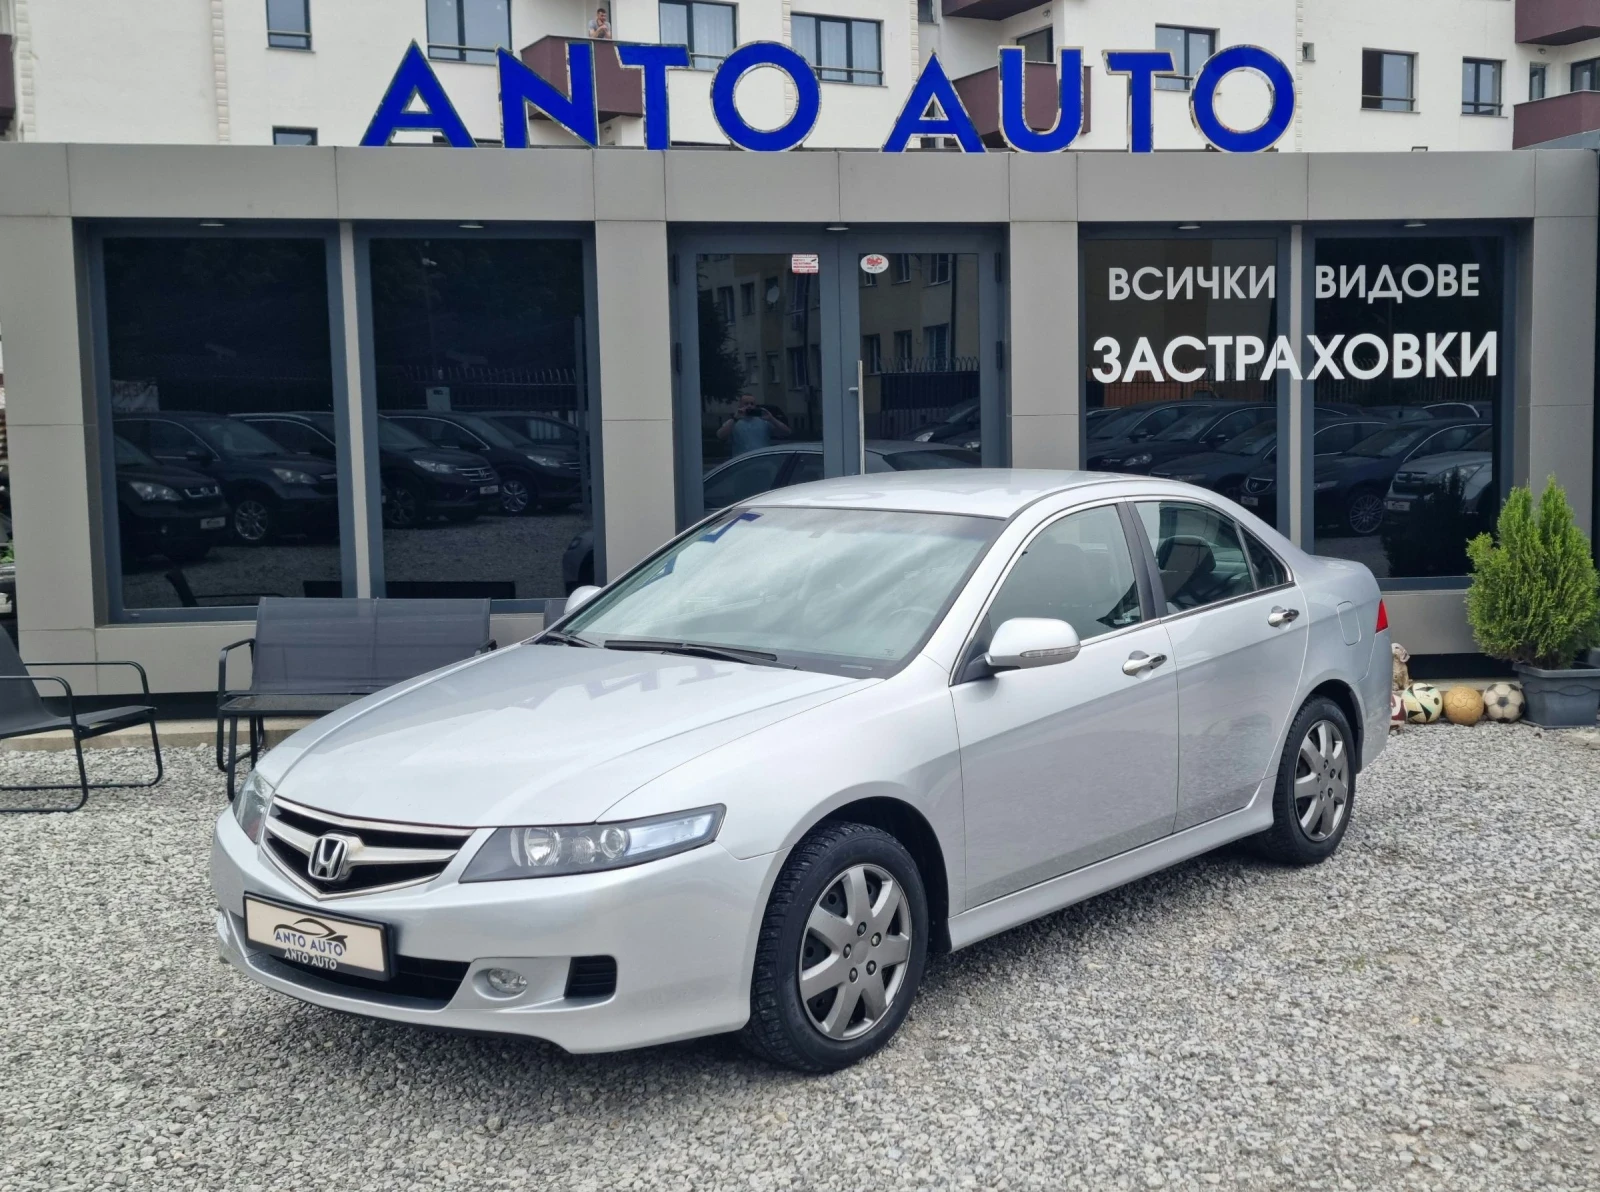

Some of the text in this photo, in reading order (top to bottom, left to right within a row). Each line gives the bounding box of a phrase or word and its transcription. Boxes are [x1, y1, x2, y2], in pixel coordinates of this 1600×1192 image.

[360, 39, 1297, 153] ANTO AUTO
[1108, 263, 1480, 304] ВСИЧКИ ВИДОВЕ
[1092, 330, 1498, 383] ЗАСТРАХОВКИ
[275, 931, 343, 957] ANTO AUTO
[284, 949, 337, 970] ANTO AUTO
